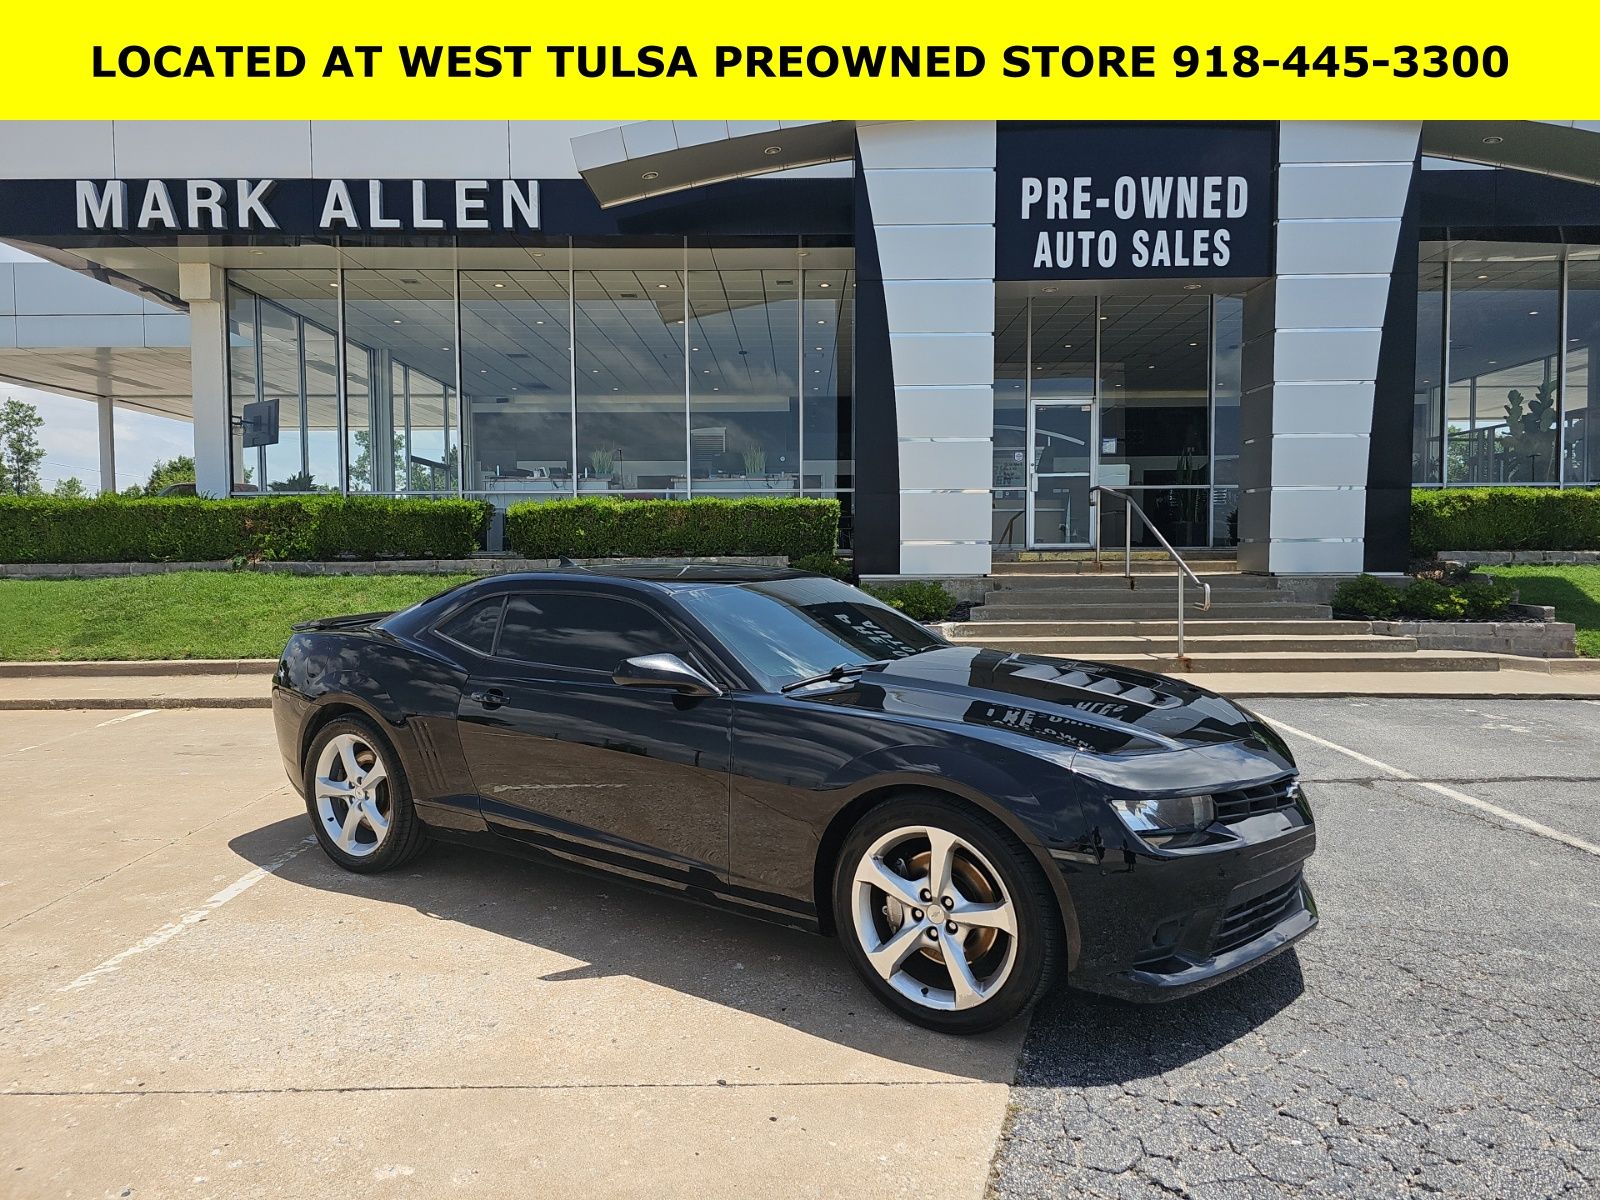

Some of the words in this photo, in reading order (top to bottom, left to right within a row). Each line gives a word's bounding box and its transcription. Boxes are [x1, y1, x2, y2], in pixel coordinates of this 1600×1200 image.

[75, 180, 280, 230] MARK
[319, 180, 542, 230] ALLEN
[1021, 175, 1249, 220] PRE-OWNED
[1033, 229, 1118, 269] AUTO
[1131, 228, 1232, 267] SALES
